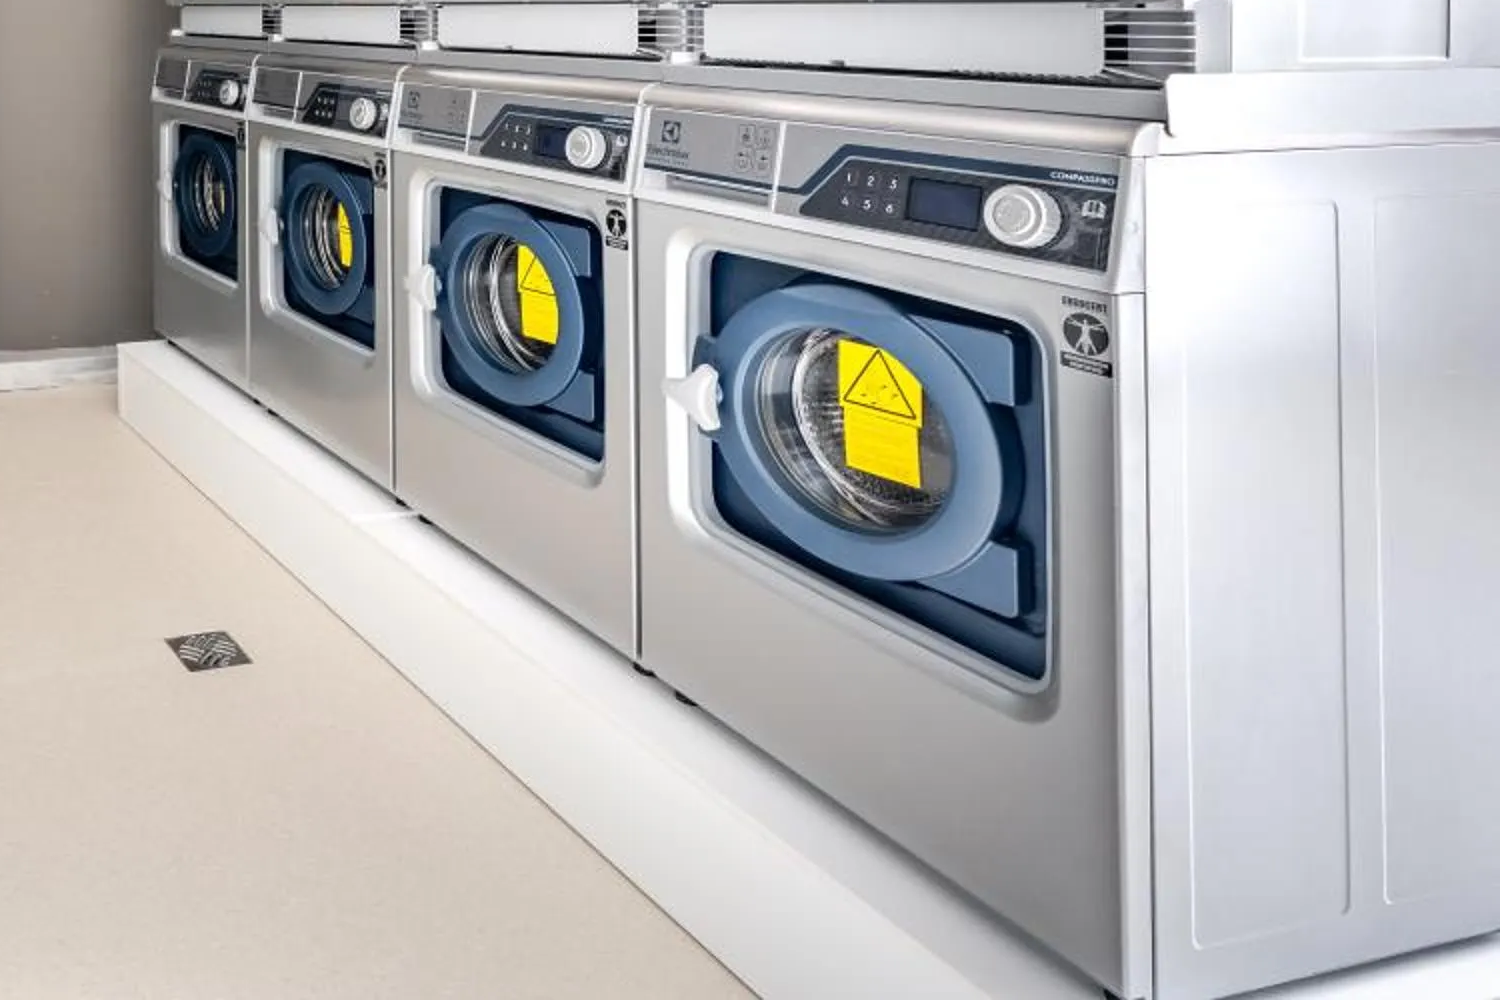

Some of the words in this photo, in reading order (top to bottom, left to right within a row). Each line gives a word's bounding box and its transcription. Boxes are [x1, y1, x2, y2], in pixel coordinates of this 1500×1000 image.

[867, 175, 875, 187] 2
[863, 199, 871, 210] 5
[885, 204, 893, 214] 6
